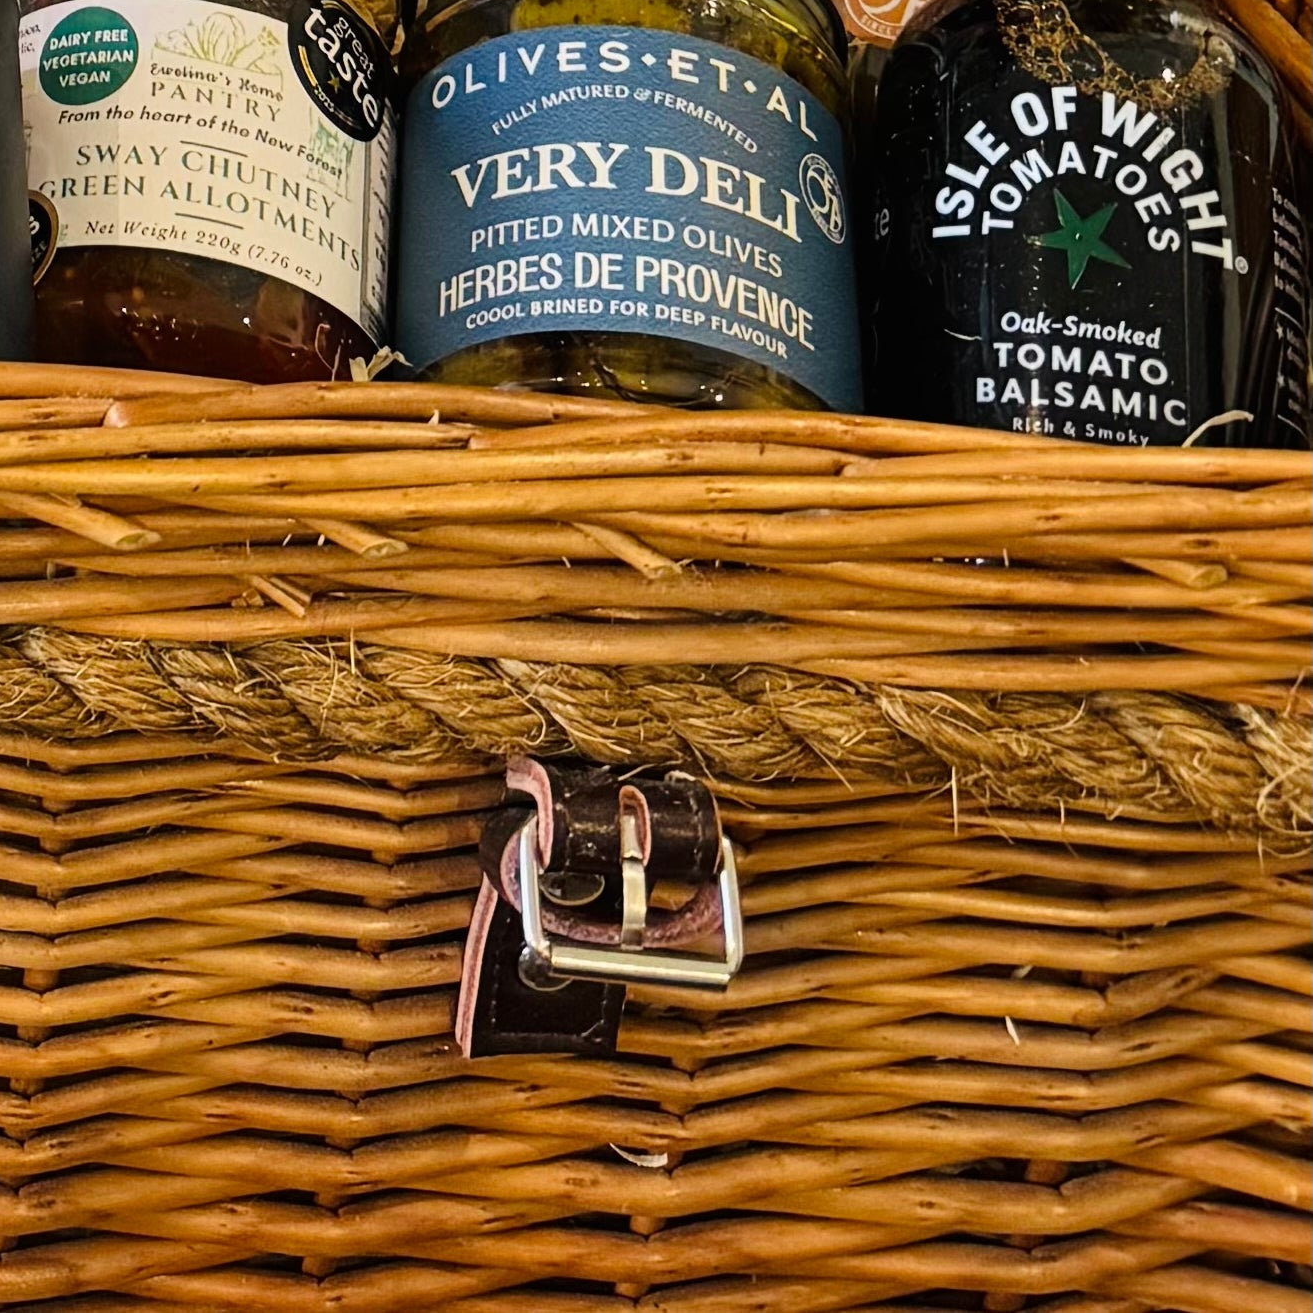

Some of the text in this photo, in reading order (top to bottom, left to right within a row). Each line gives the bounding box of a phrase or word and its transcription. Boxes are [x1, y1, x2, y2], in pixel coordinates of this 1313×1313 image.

[58, 71, 111, 87] VEGAN
[76, 144, 337, 220] SWAY CHUTNEY
[450, 141, 803, 244] VERY DELI
[932, 86, 1235, 270] ISLE OF WIGHT
[981, 141, 1181, 253] TOMATOES
[39, 177, 361, 272] GREEN ALLOTMENTS
[471, 213, 783, 278] PITTED MIXED OLIVES
[438, 252, 815, 351] HERBES DE PROVENCE
[530, 299, 603, 317] BRINED
[609, 300, 649, 317] FOR
[655, 304, 705, 325] DEEP
[711, 316, 788, 359] FLAVOUR
[1001, 312, 1162, 349] Oak-Smoked
[994, 342, 1169, 386] TOMATO
[976, 377, 1188, 427] BALSAMIC
